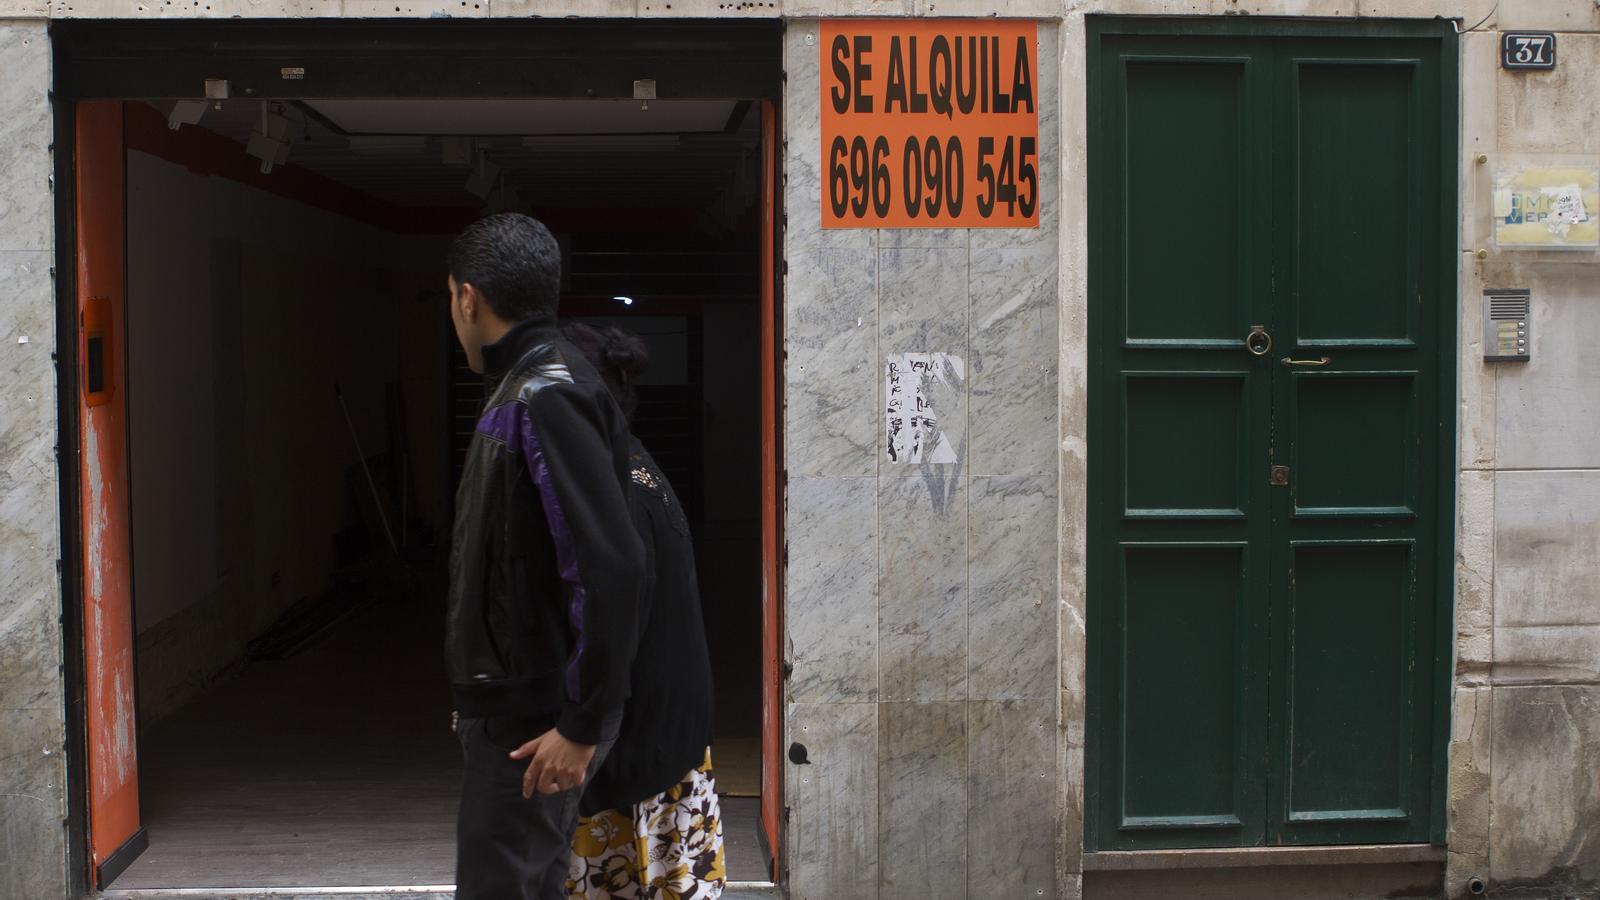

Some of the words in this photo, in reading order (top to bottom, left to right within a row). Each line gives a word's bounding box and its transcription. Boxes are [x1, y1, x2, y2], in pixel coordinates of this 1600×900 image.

[831, 34, 873, 114] SE
[884, 34, 1034, 121] ALQUILA
[1516, 38, 1546, 62] 37
[829, 135, 891, 218] 696
[903, 135, 964, 218] 090
[976, 135, 1037, 218] 545
